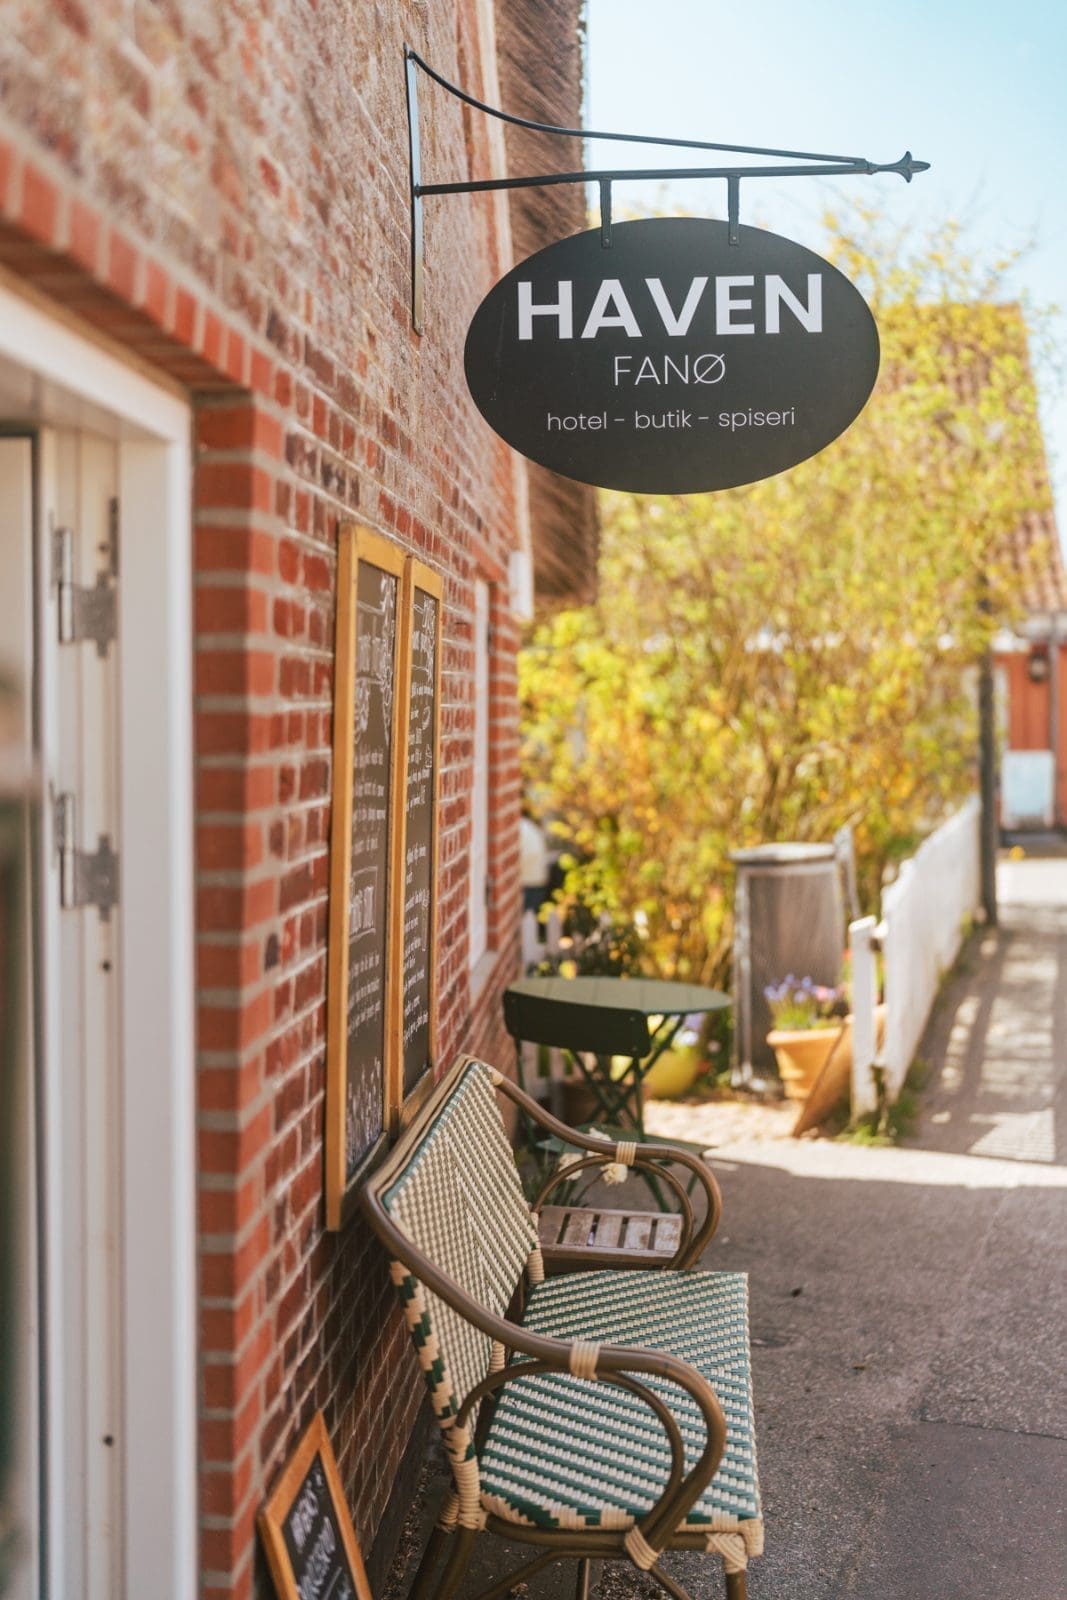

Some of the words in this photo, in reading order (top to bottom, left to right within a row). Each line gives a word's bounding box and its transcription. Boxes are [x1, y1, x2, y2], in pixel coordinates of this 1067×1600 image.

[517, 273, 823, 341] HAVEN
[613, 352, 727, 387] FANØ
[547, 410, 607, 431] hotel
[634, 409, 693, 430] butik
[718, 406, 795, 433] spiseri
